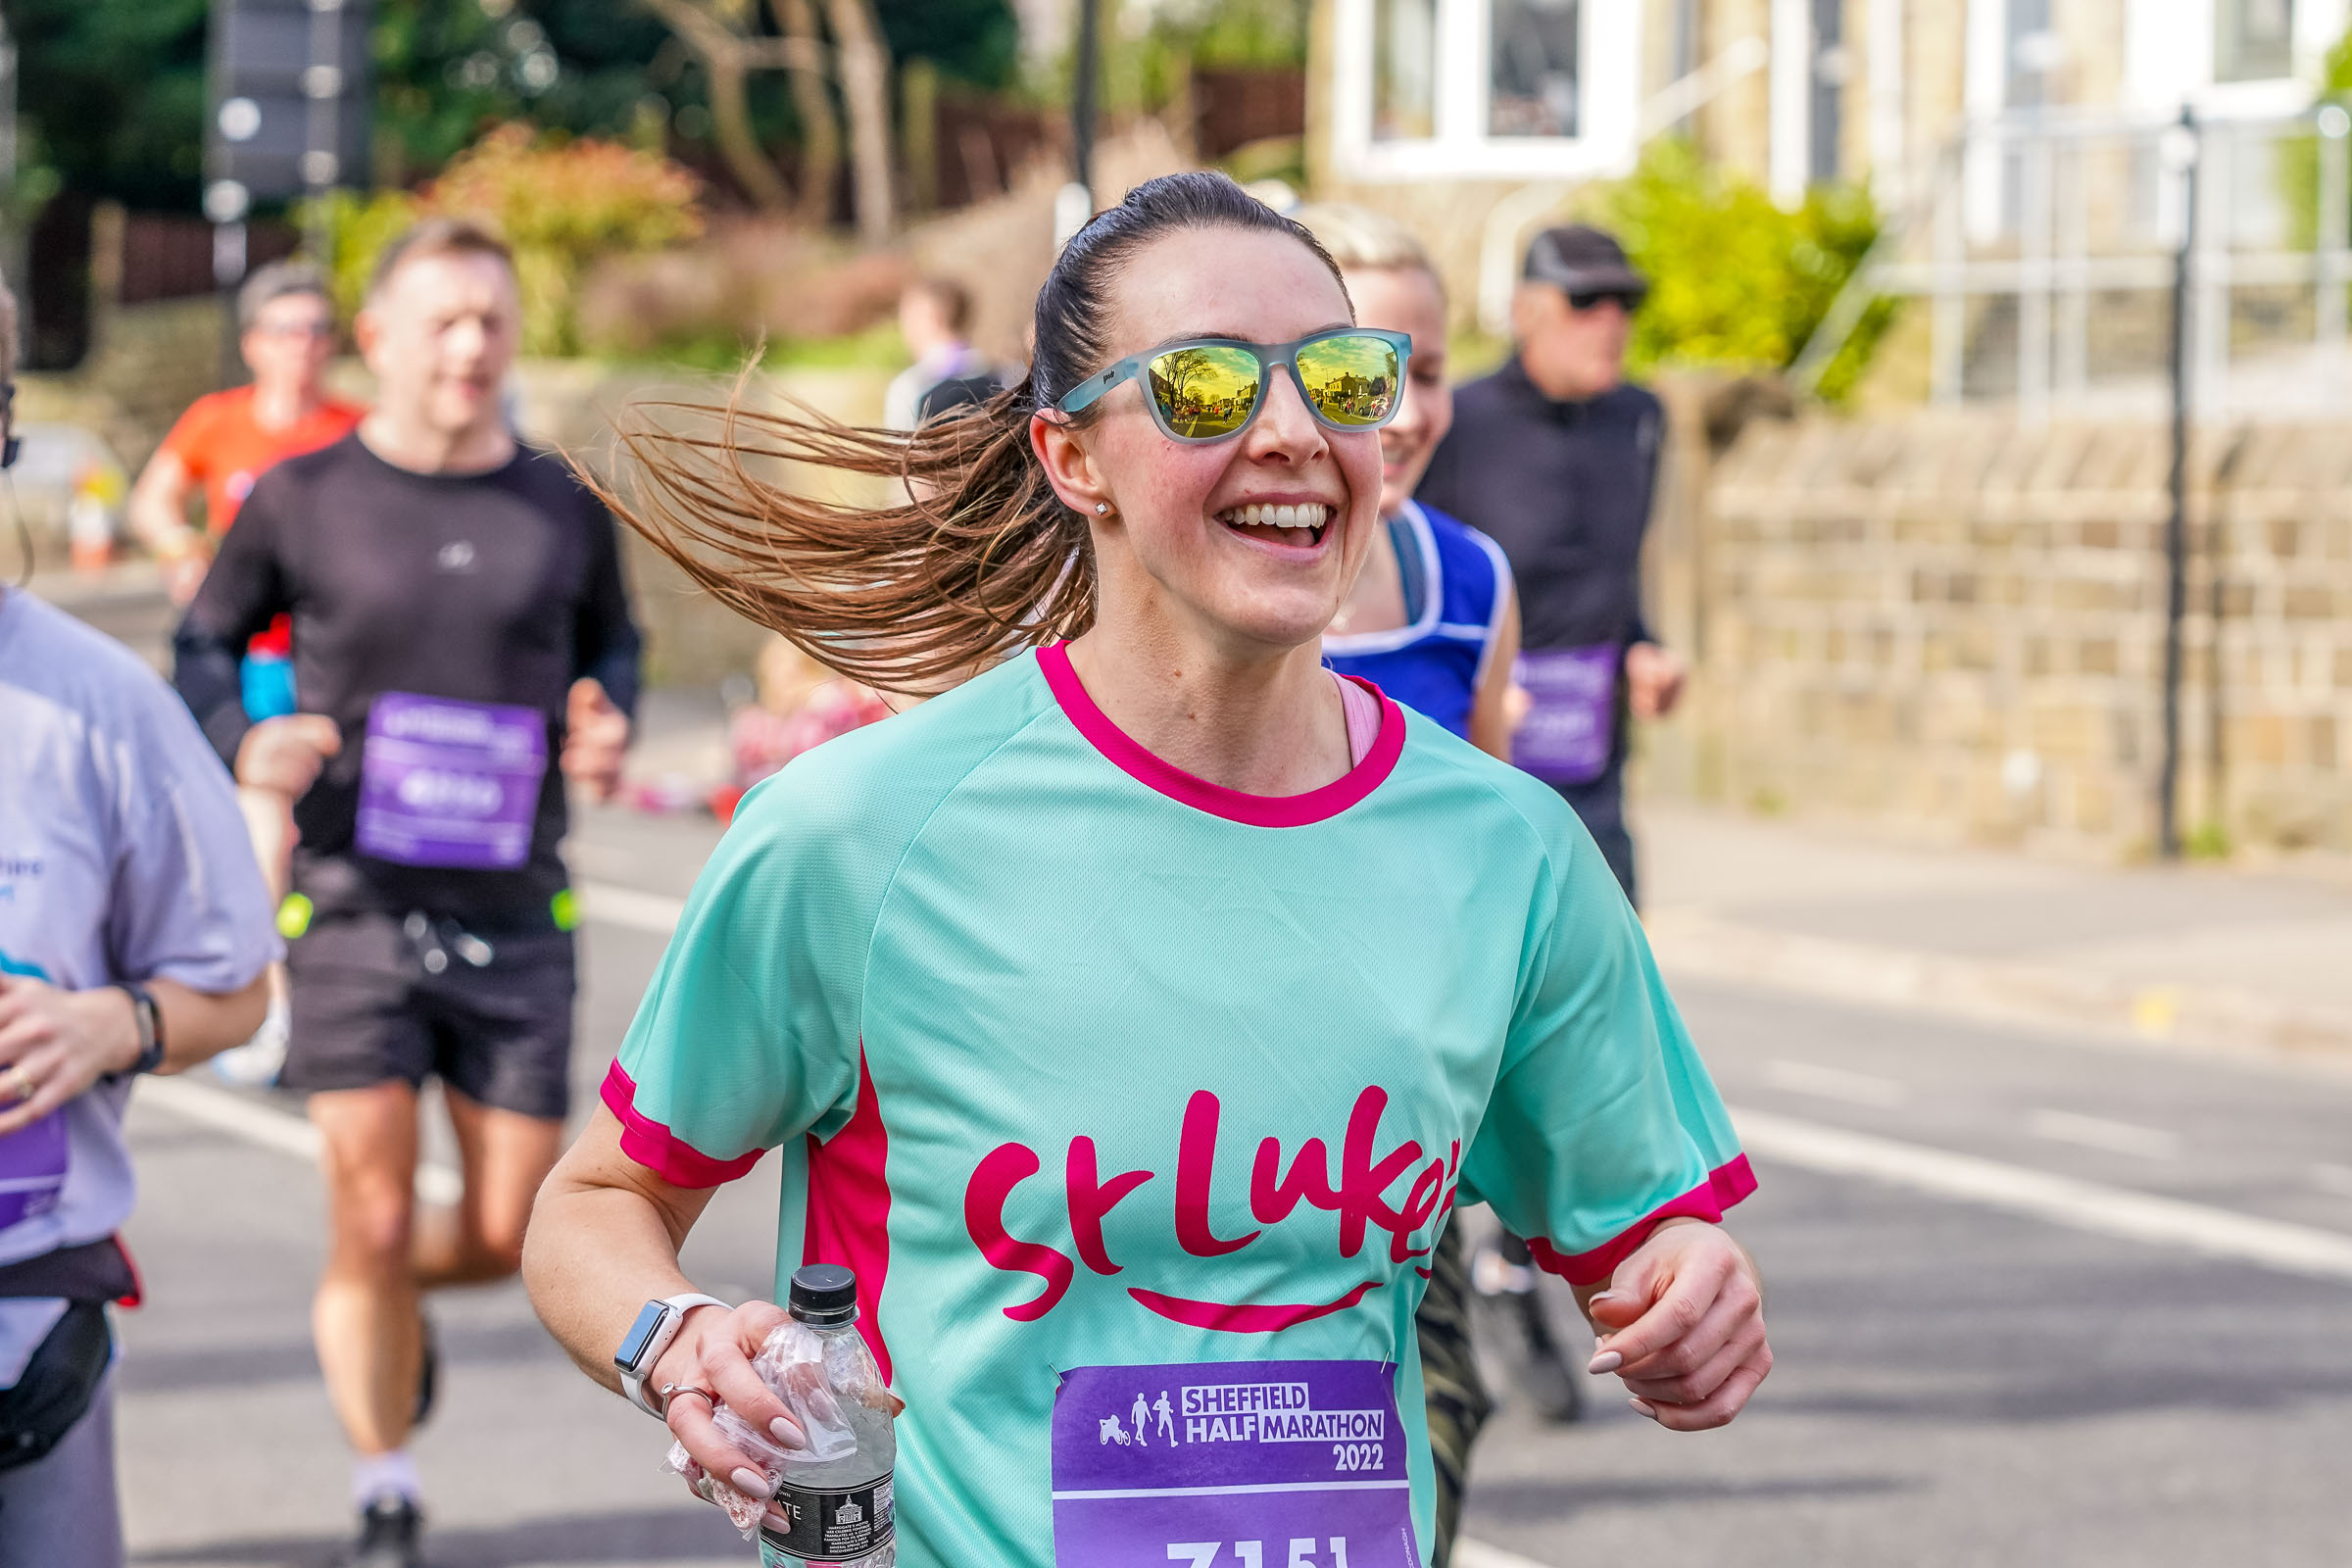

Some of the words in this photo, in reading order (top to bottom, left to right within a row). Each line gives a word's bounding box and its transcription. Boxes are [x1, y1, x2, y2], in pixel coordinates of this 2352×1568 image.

[1186, 1385, 1307, 1413] SHEFFIELD
[1186, 1415, 1258, 1444] HALF
[1262, 1413, 1383, 1441] MARATHON
[1333, 1443, 1384, 1471] 2022
